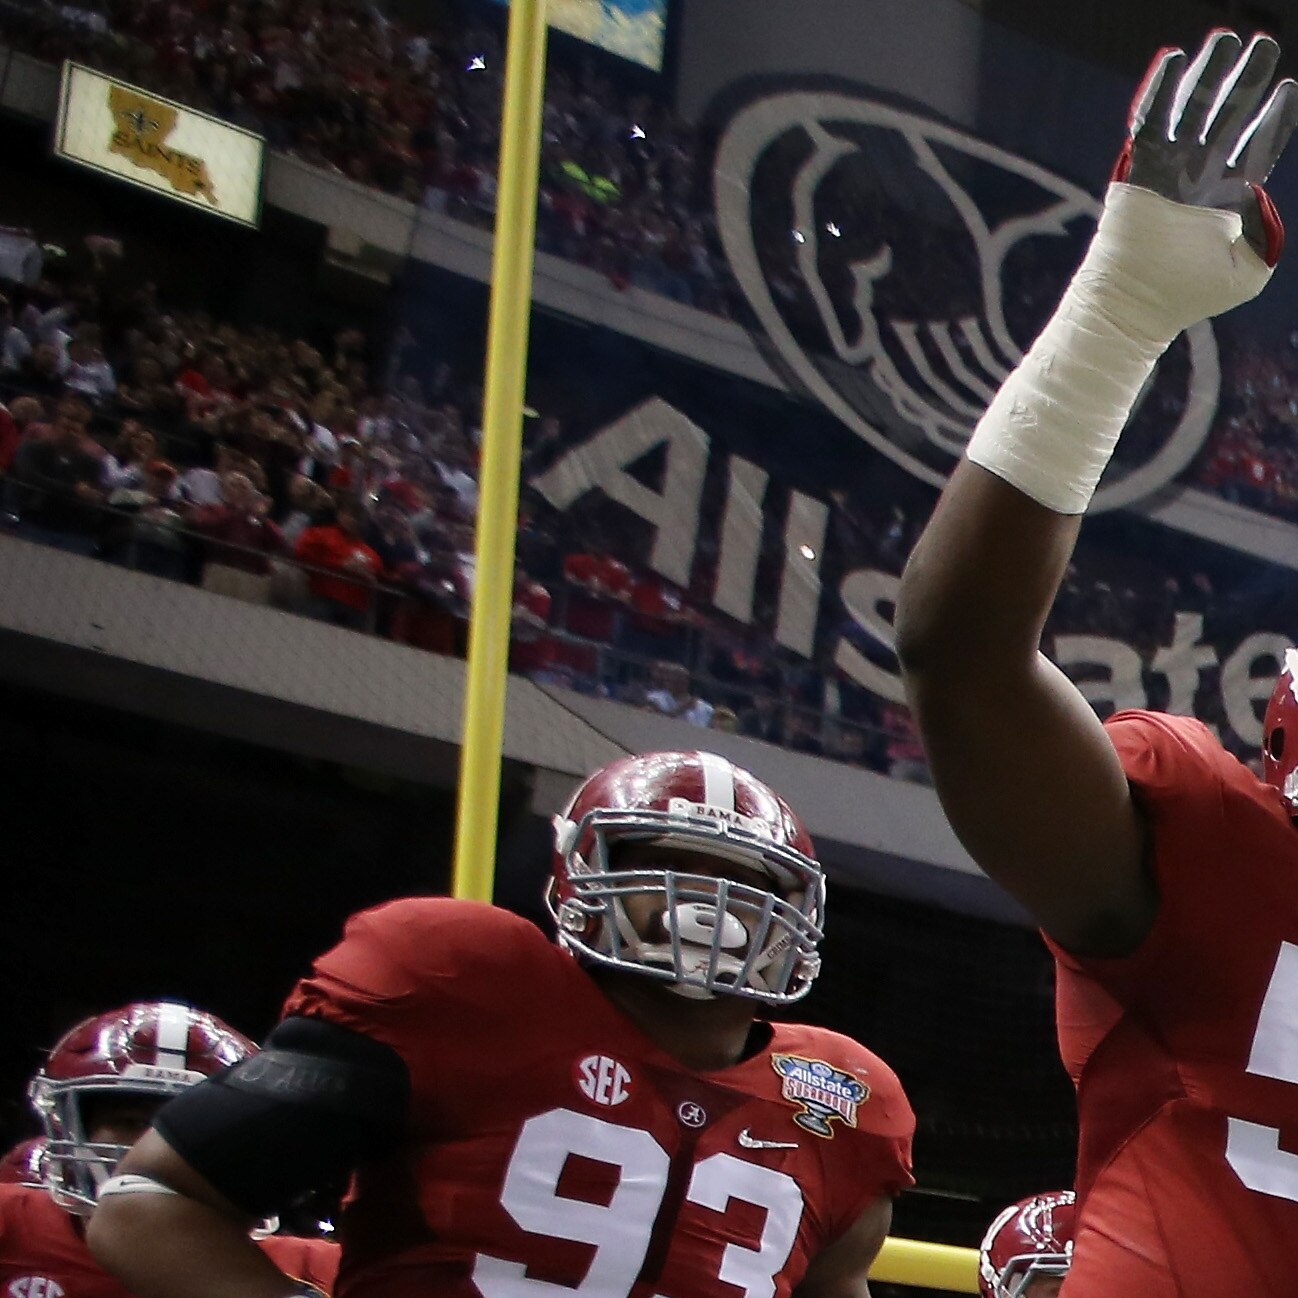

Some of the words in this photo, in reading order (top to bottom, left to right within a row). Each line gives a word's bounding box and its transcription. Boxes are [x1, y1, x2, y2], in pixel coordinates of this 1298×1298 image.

[532, 397, 1290, 748] Allsate
[697, 806, 743, 826] BAMA
[579, 1054, 632, 1106] SEC
[788, 1066, 852, 1098] Allstate
